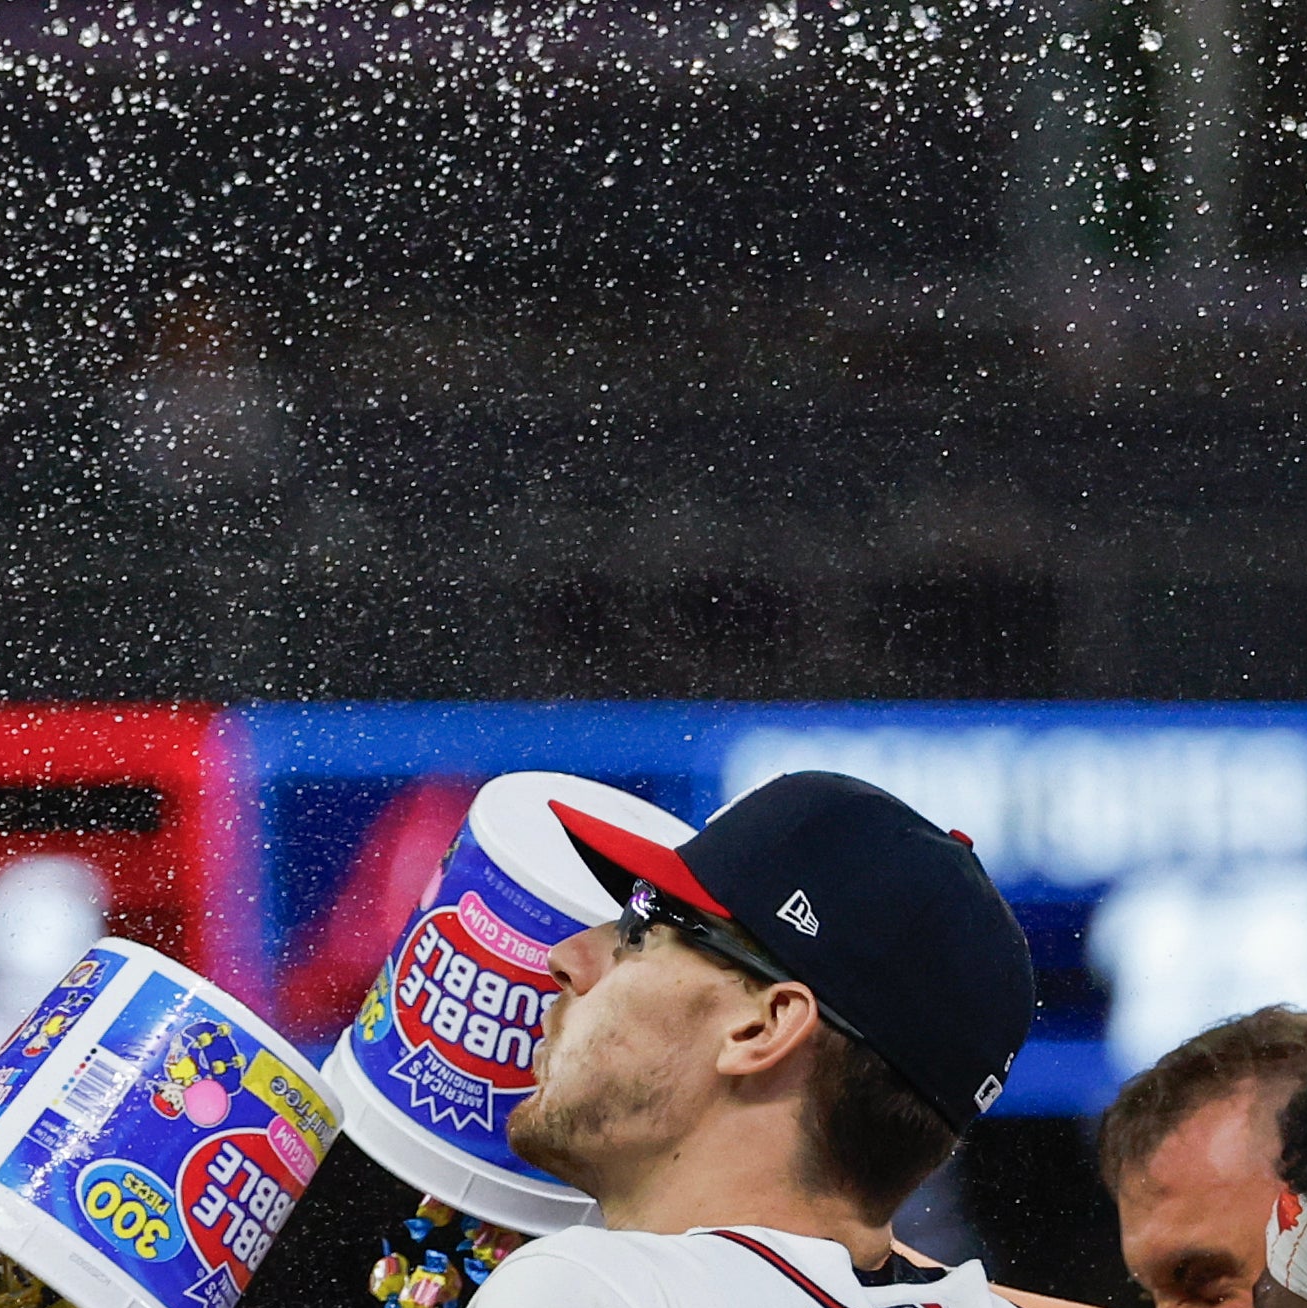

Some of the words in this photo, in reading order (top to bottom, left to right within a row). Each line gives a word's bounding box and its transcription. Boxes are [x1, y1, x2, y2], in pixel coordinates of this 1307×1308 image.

[463, 901, 500, 941] GUM
[497, 931, 552, 971] UBBLE
[398, 963, 539, 1069] UBBLE
[408, 1060, 484, 1110] AMERICA'S
[425, 1051, 484, 1096] ORIGINAL
[122, 1172, 171, 1216] PIECES
[207, 1141, 296, 1234] BBLE
[85, 1180, 171, 1260] 300
[191, 1183, 274, 1273] BBLE
